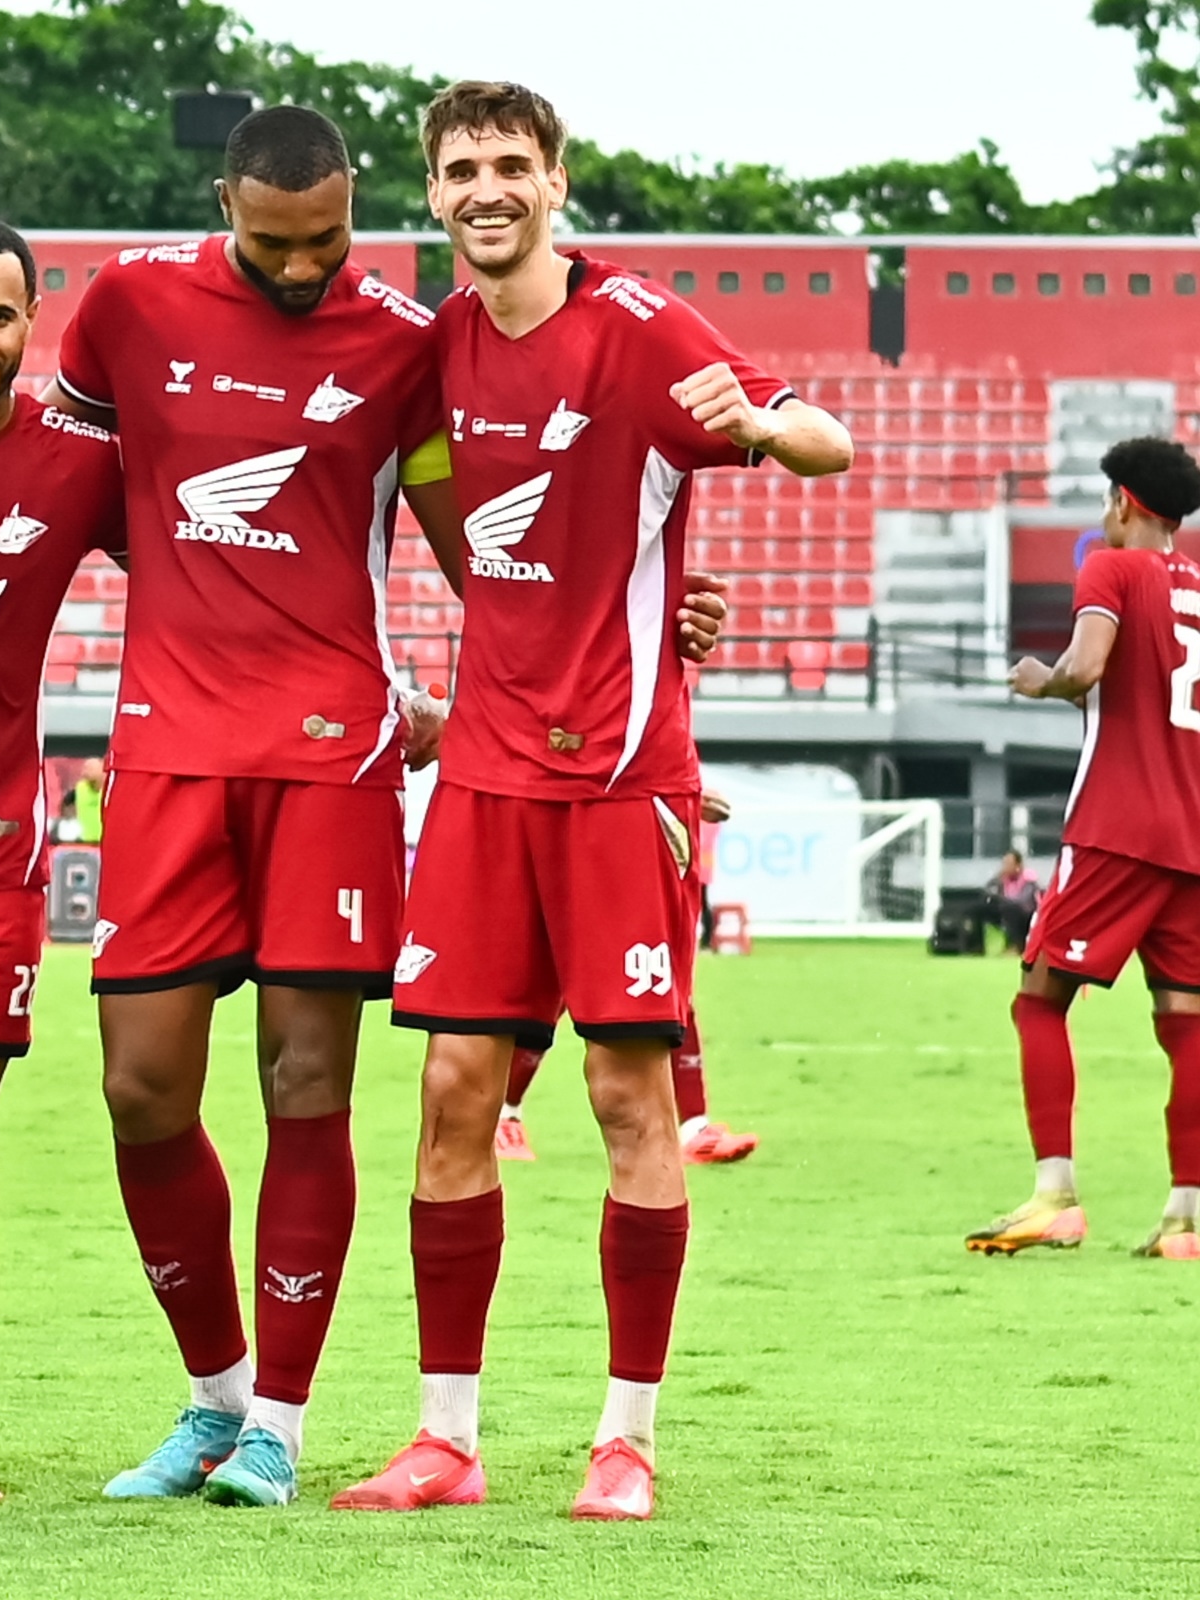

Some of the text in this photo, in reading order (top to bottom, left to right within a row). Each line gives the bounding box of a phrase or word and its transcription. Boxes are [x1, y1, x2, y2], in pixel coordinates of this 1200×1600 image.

[173, 521, 300, 554] HONDA
[337, 888, 363, 943] 4
[624, 942, 672, 998] 99
